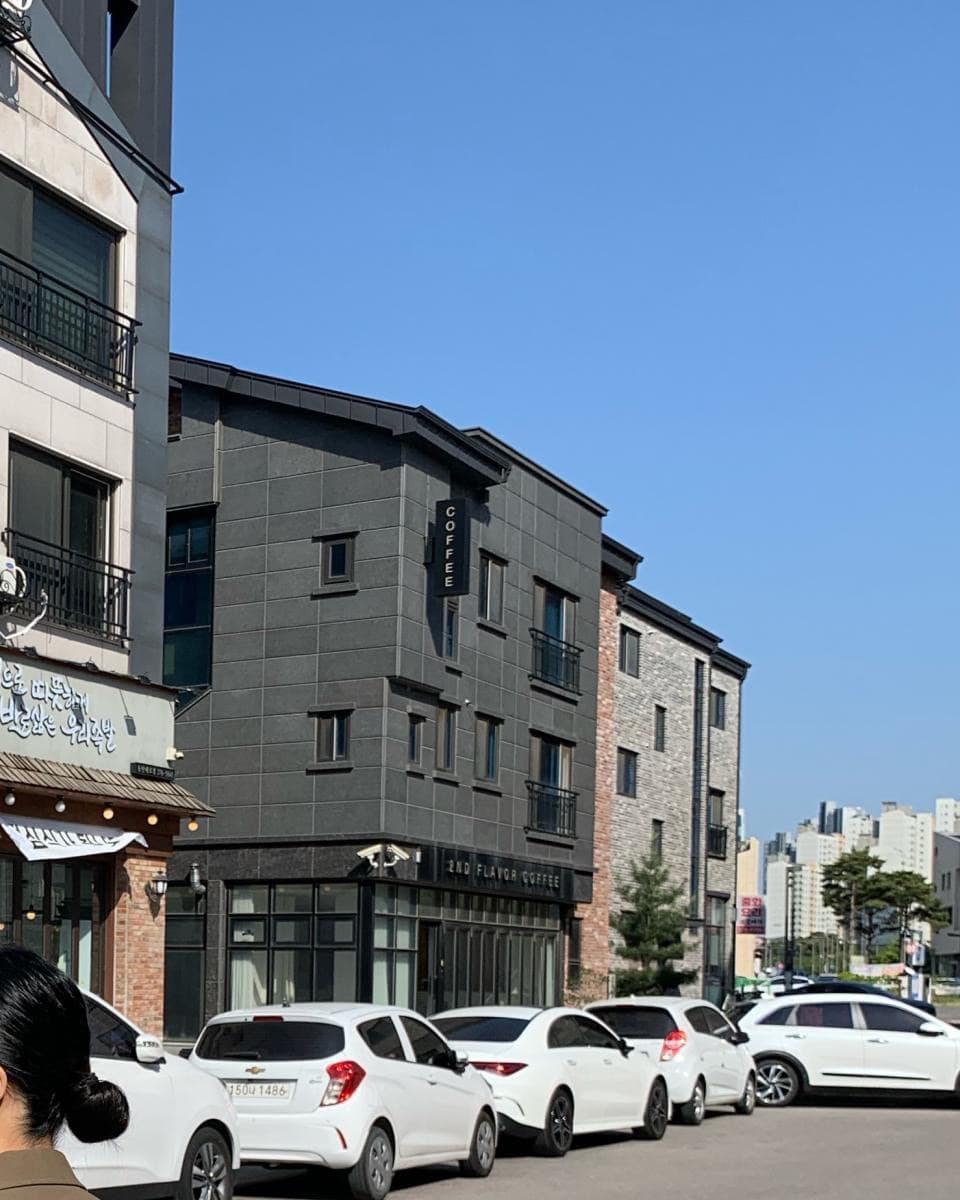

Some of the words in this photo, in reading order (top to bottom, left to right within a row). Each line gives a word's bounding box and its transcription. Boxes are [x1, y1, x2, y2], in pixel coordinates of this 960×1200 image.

[444, 506, 456, 587] COFFEE
[448, 859, 470, 875] 2ND
[477, 864, 517, 881] FLAVOR
[522, 870, 560, 888] COFFEE
[259, 1085, 286, 1096] 1486
